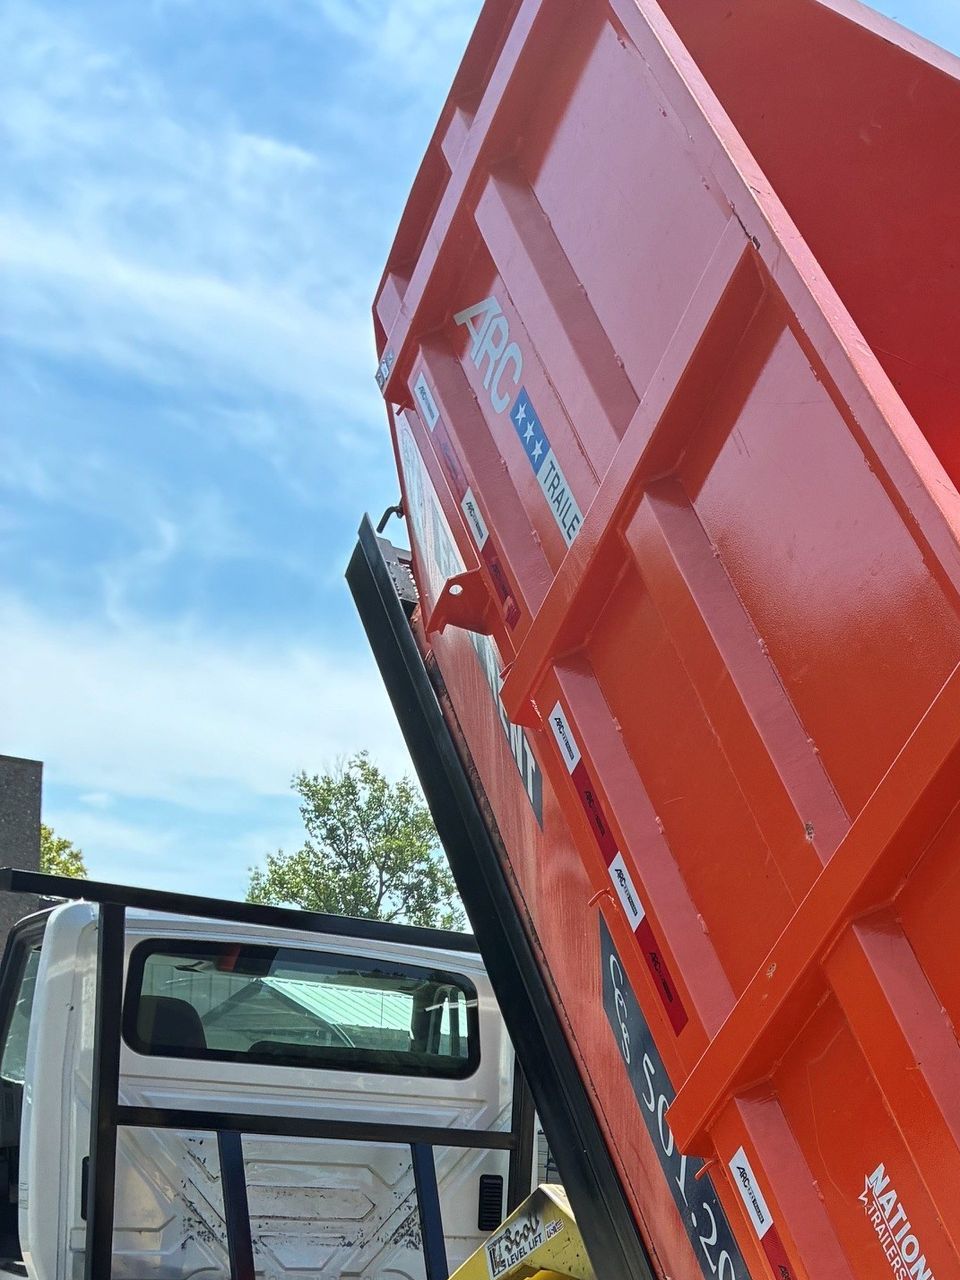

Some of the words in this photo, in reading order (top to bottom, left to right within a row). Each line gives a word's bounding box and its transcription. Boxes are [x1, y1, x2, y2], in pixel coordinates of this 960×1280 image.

[453, 295, 524, 414] ARC
[506, 1246, 528, 1268] LEVEL
[528, 1232, 543, 1251] LIFT
